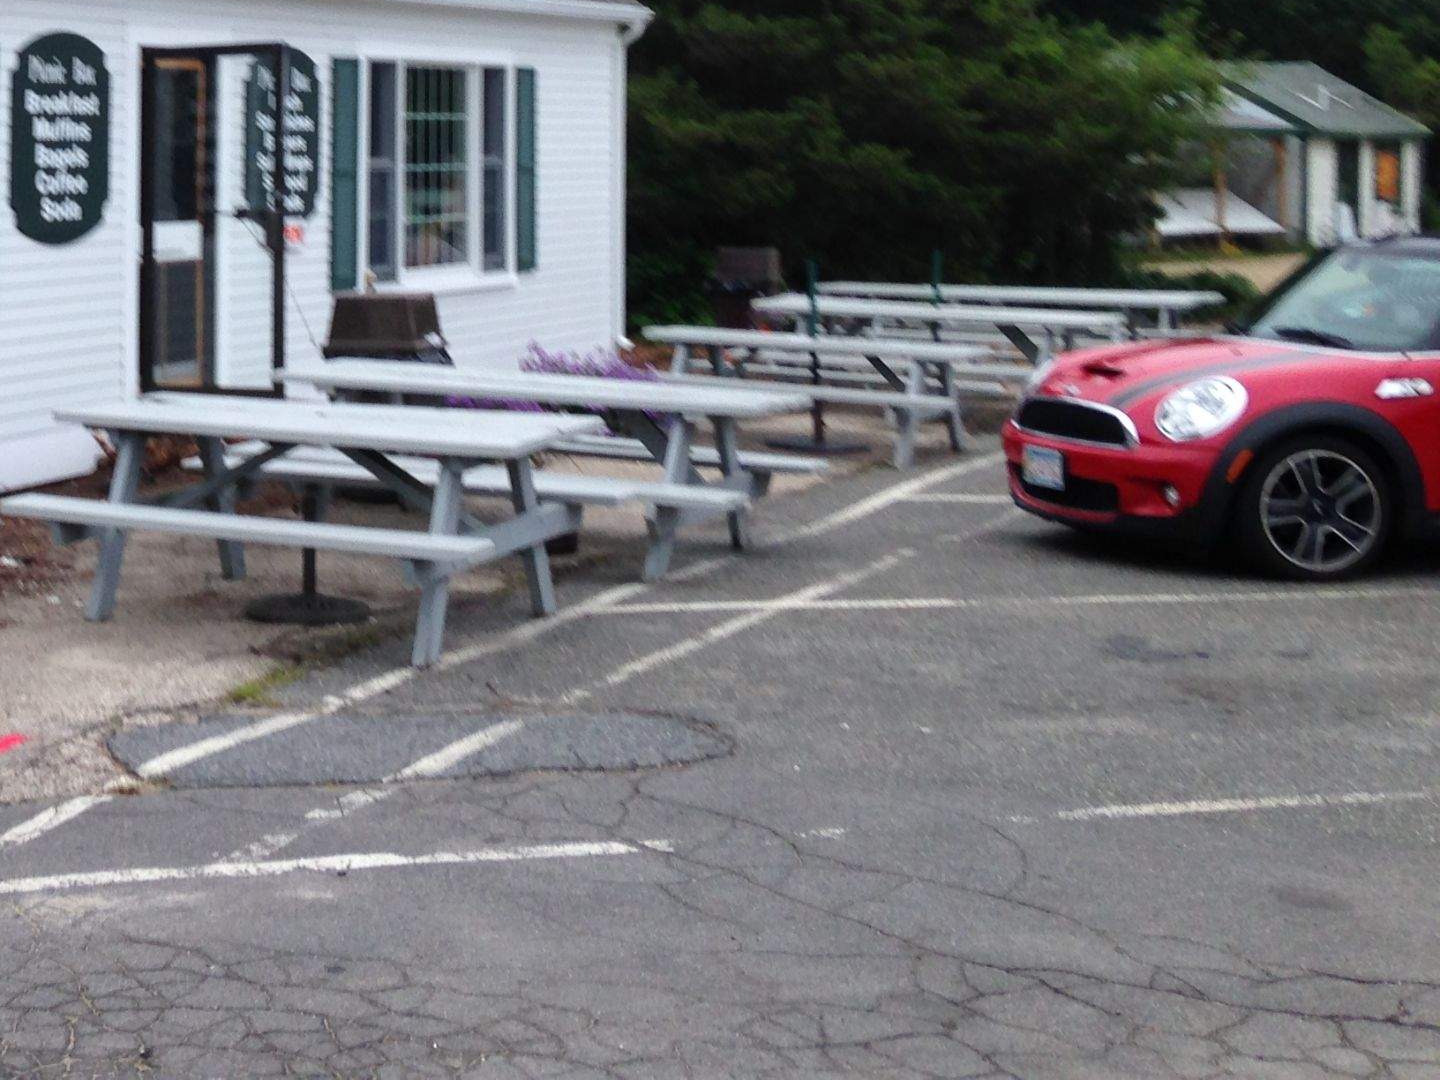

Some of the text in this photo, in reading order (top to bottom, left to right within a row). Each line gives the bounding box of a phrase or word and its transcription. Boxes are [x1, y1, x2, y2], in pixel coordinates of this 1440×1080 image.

[24, 88, 100, 116] Breakfast
[32, 116, 92, 142] Muffins
[34, 142, 90, 171] Bagels
